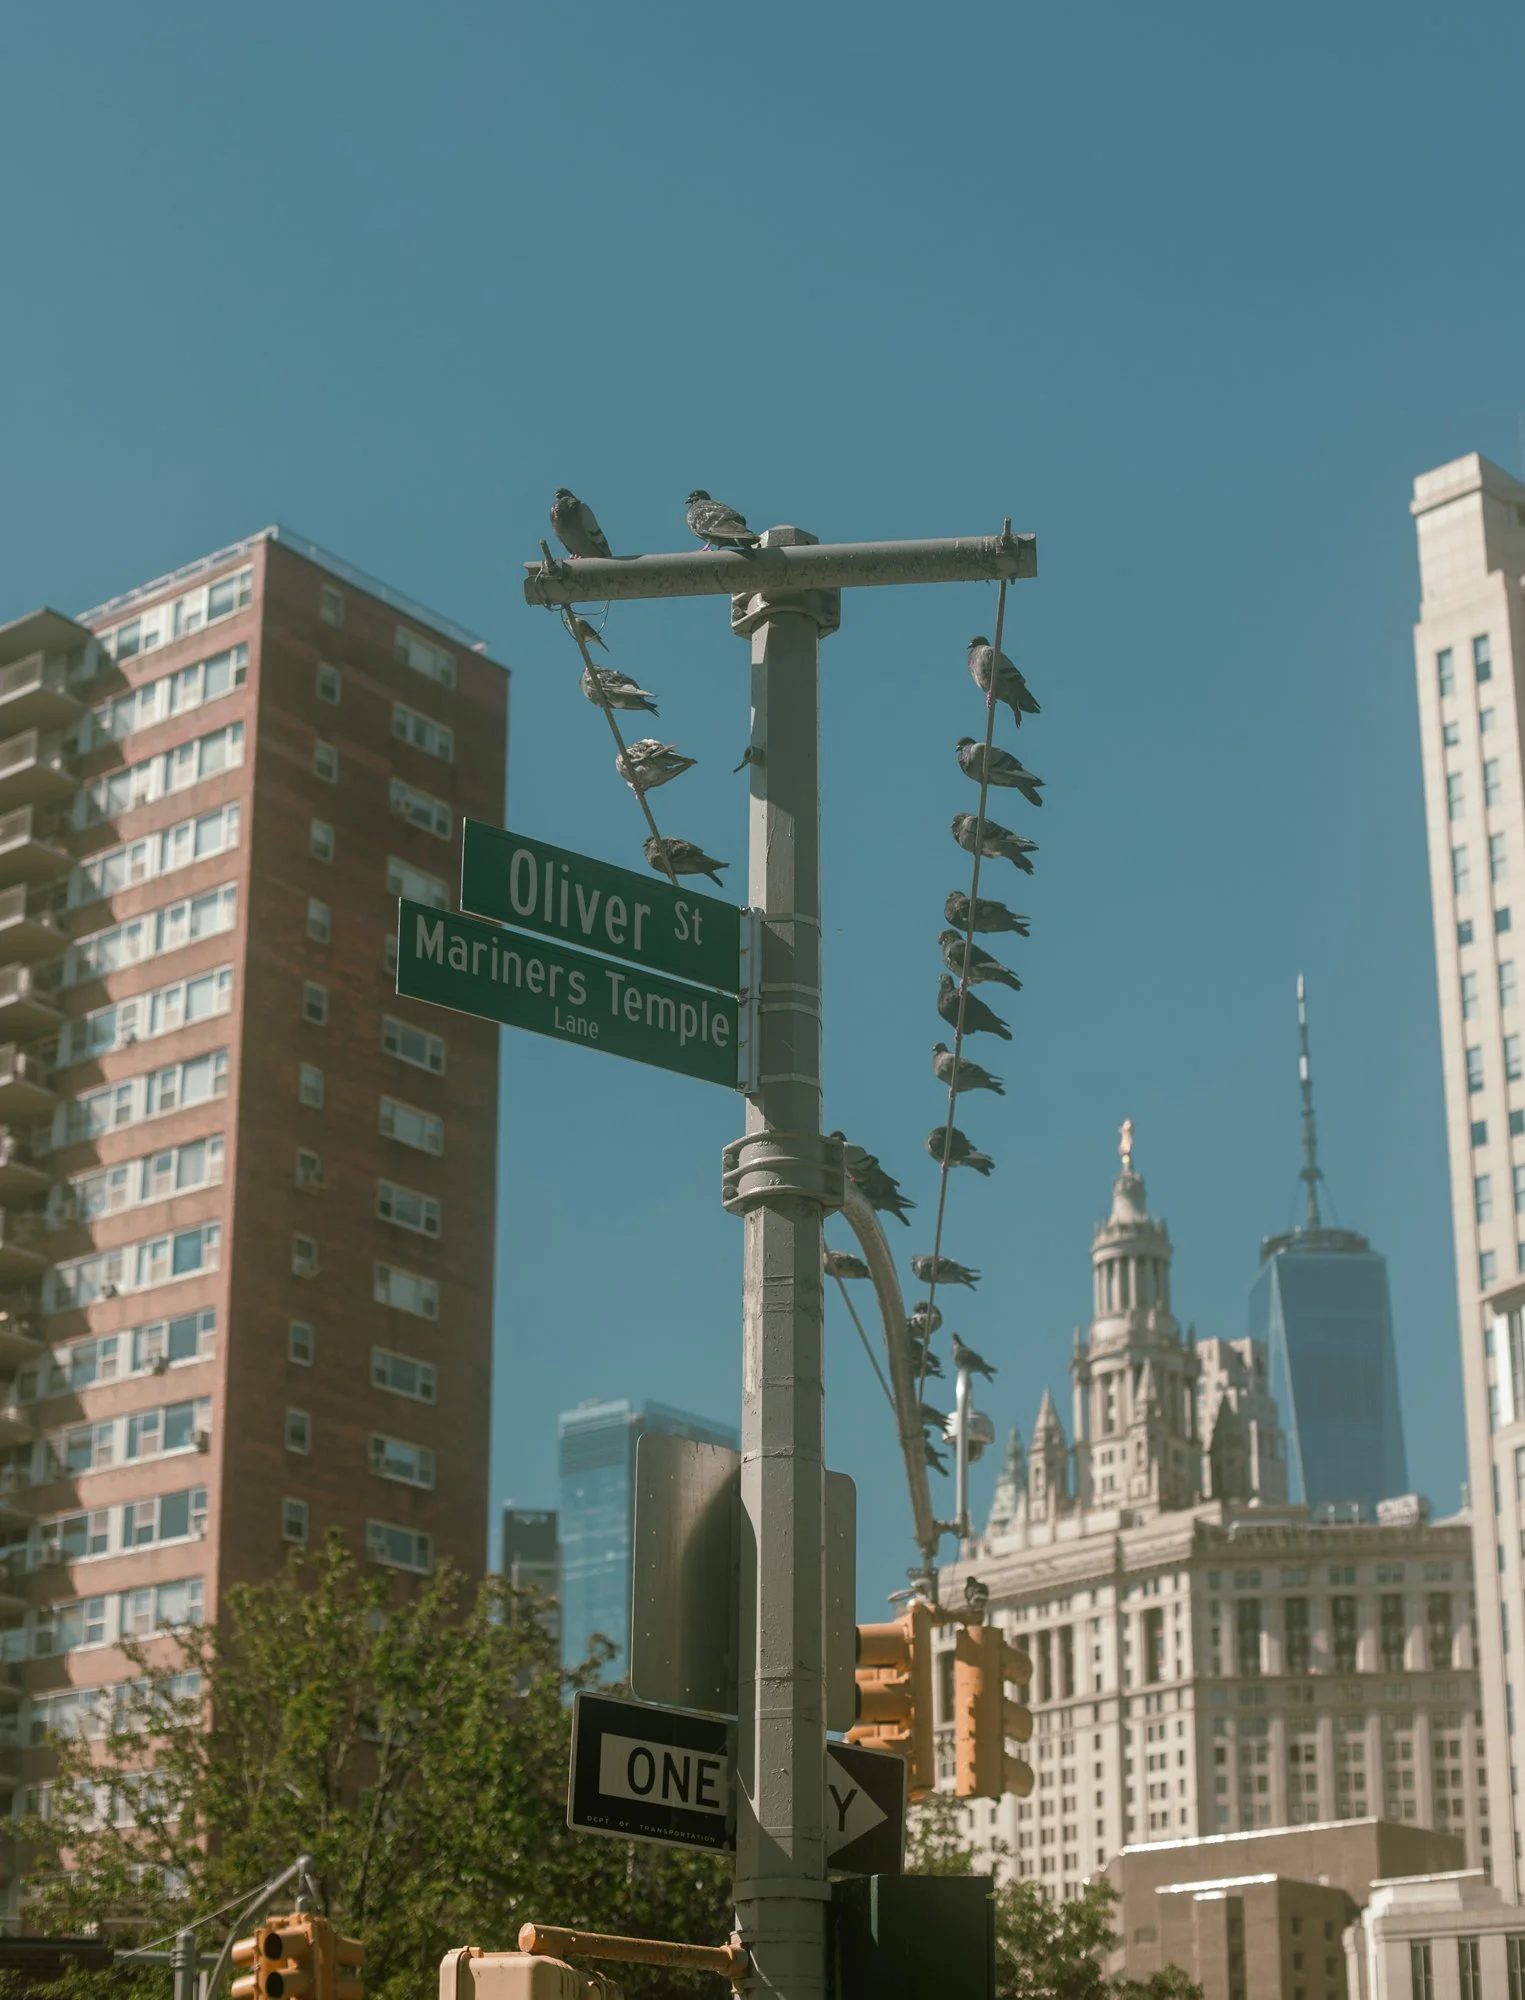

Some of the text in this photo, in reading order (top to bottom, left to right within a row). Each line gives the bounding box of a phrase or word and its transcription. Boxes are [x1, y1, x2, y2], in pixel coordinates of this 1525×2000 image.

[509, 848, 703, 951] Oliver St
[415, 914, 731, 1048] Mariners Temple
[553, 1006, 600, 1039] Lane
[627, 1746, 720, 1808] ONE
[619, 1820, 629, 1828] OF
[640, 1824, 716, 1843] TRANSPORTATION
